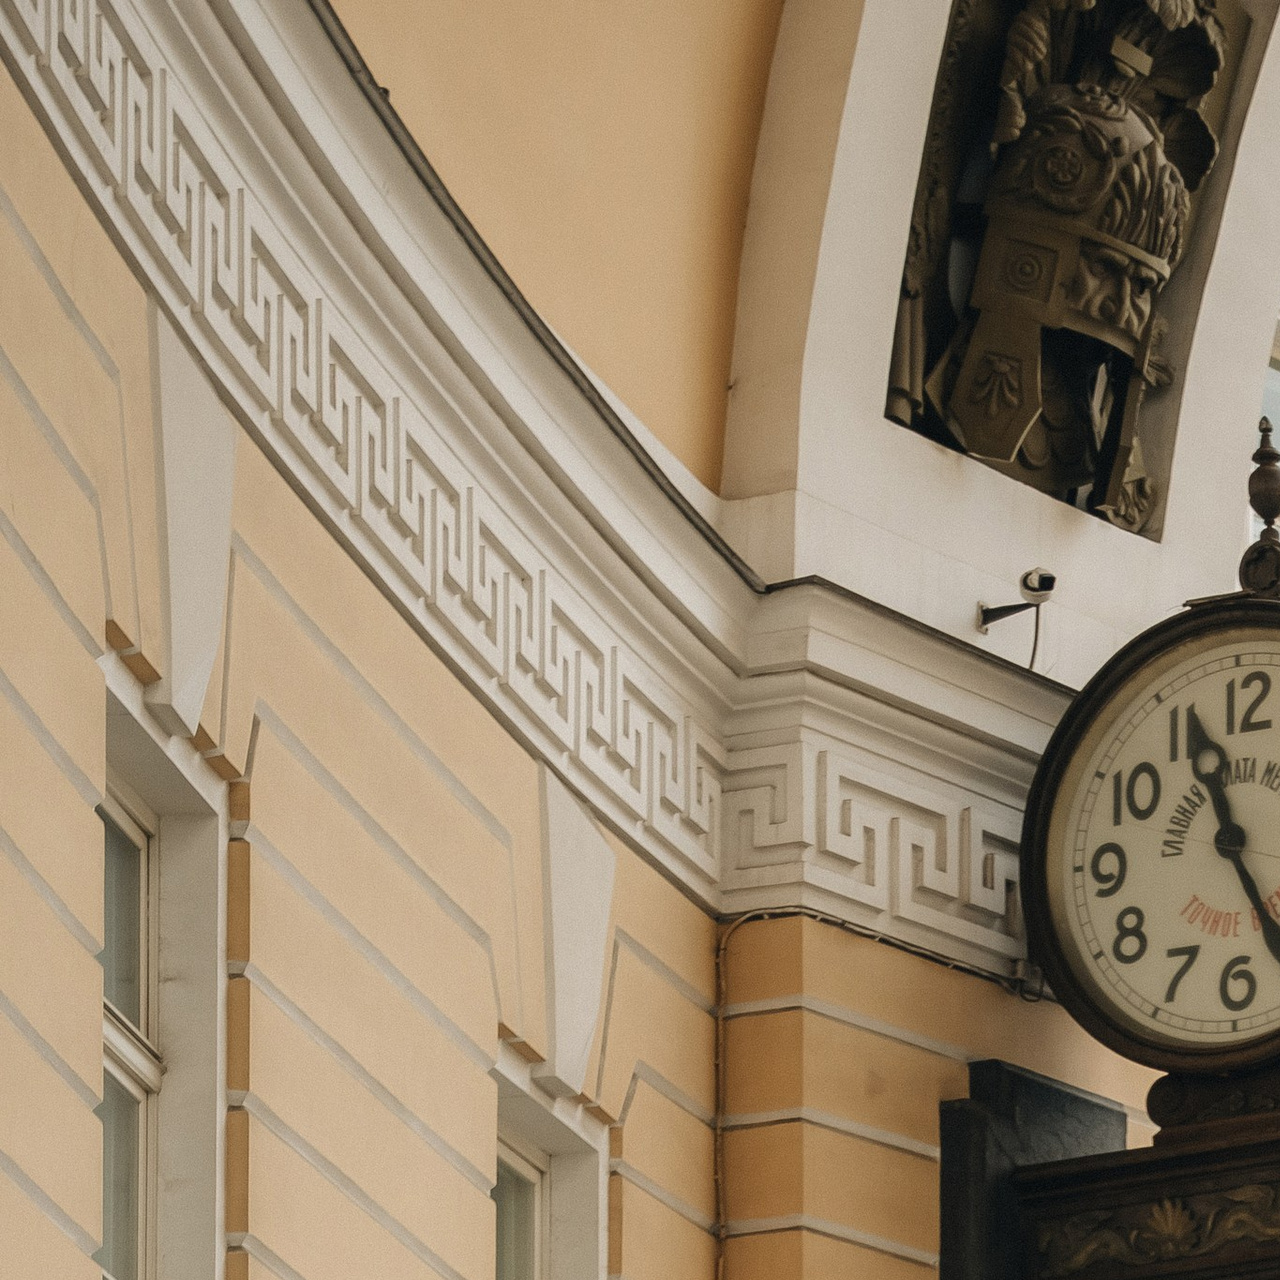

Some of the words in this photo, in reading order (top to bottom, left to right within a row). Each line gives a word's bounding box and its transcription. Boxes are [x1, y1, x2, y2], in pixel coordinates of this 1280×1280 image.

[1169, 702, 1195, 762] 11
[1226, 671, 1272, 735] 12
[1112, 761, 1161, 826] 10
[1161, 784, 1207, 858] ГЛАВНАЯ
[1091, 842, 1127, 898] 9
[1112, 906, 1148, 964] 8
[1179, 894, 1241, 938] ТОЧНОЕ
[1164, 944, 1200, 1003] 7
[1219, 955, 1257, 1012] 6
